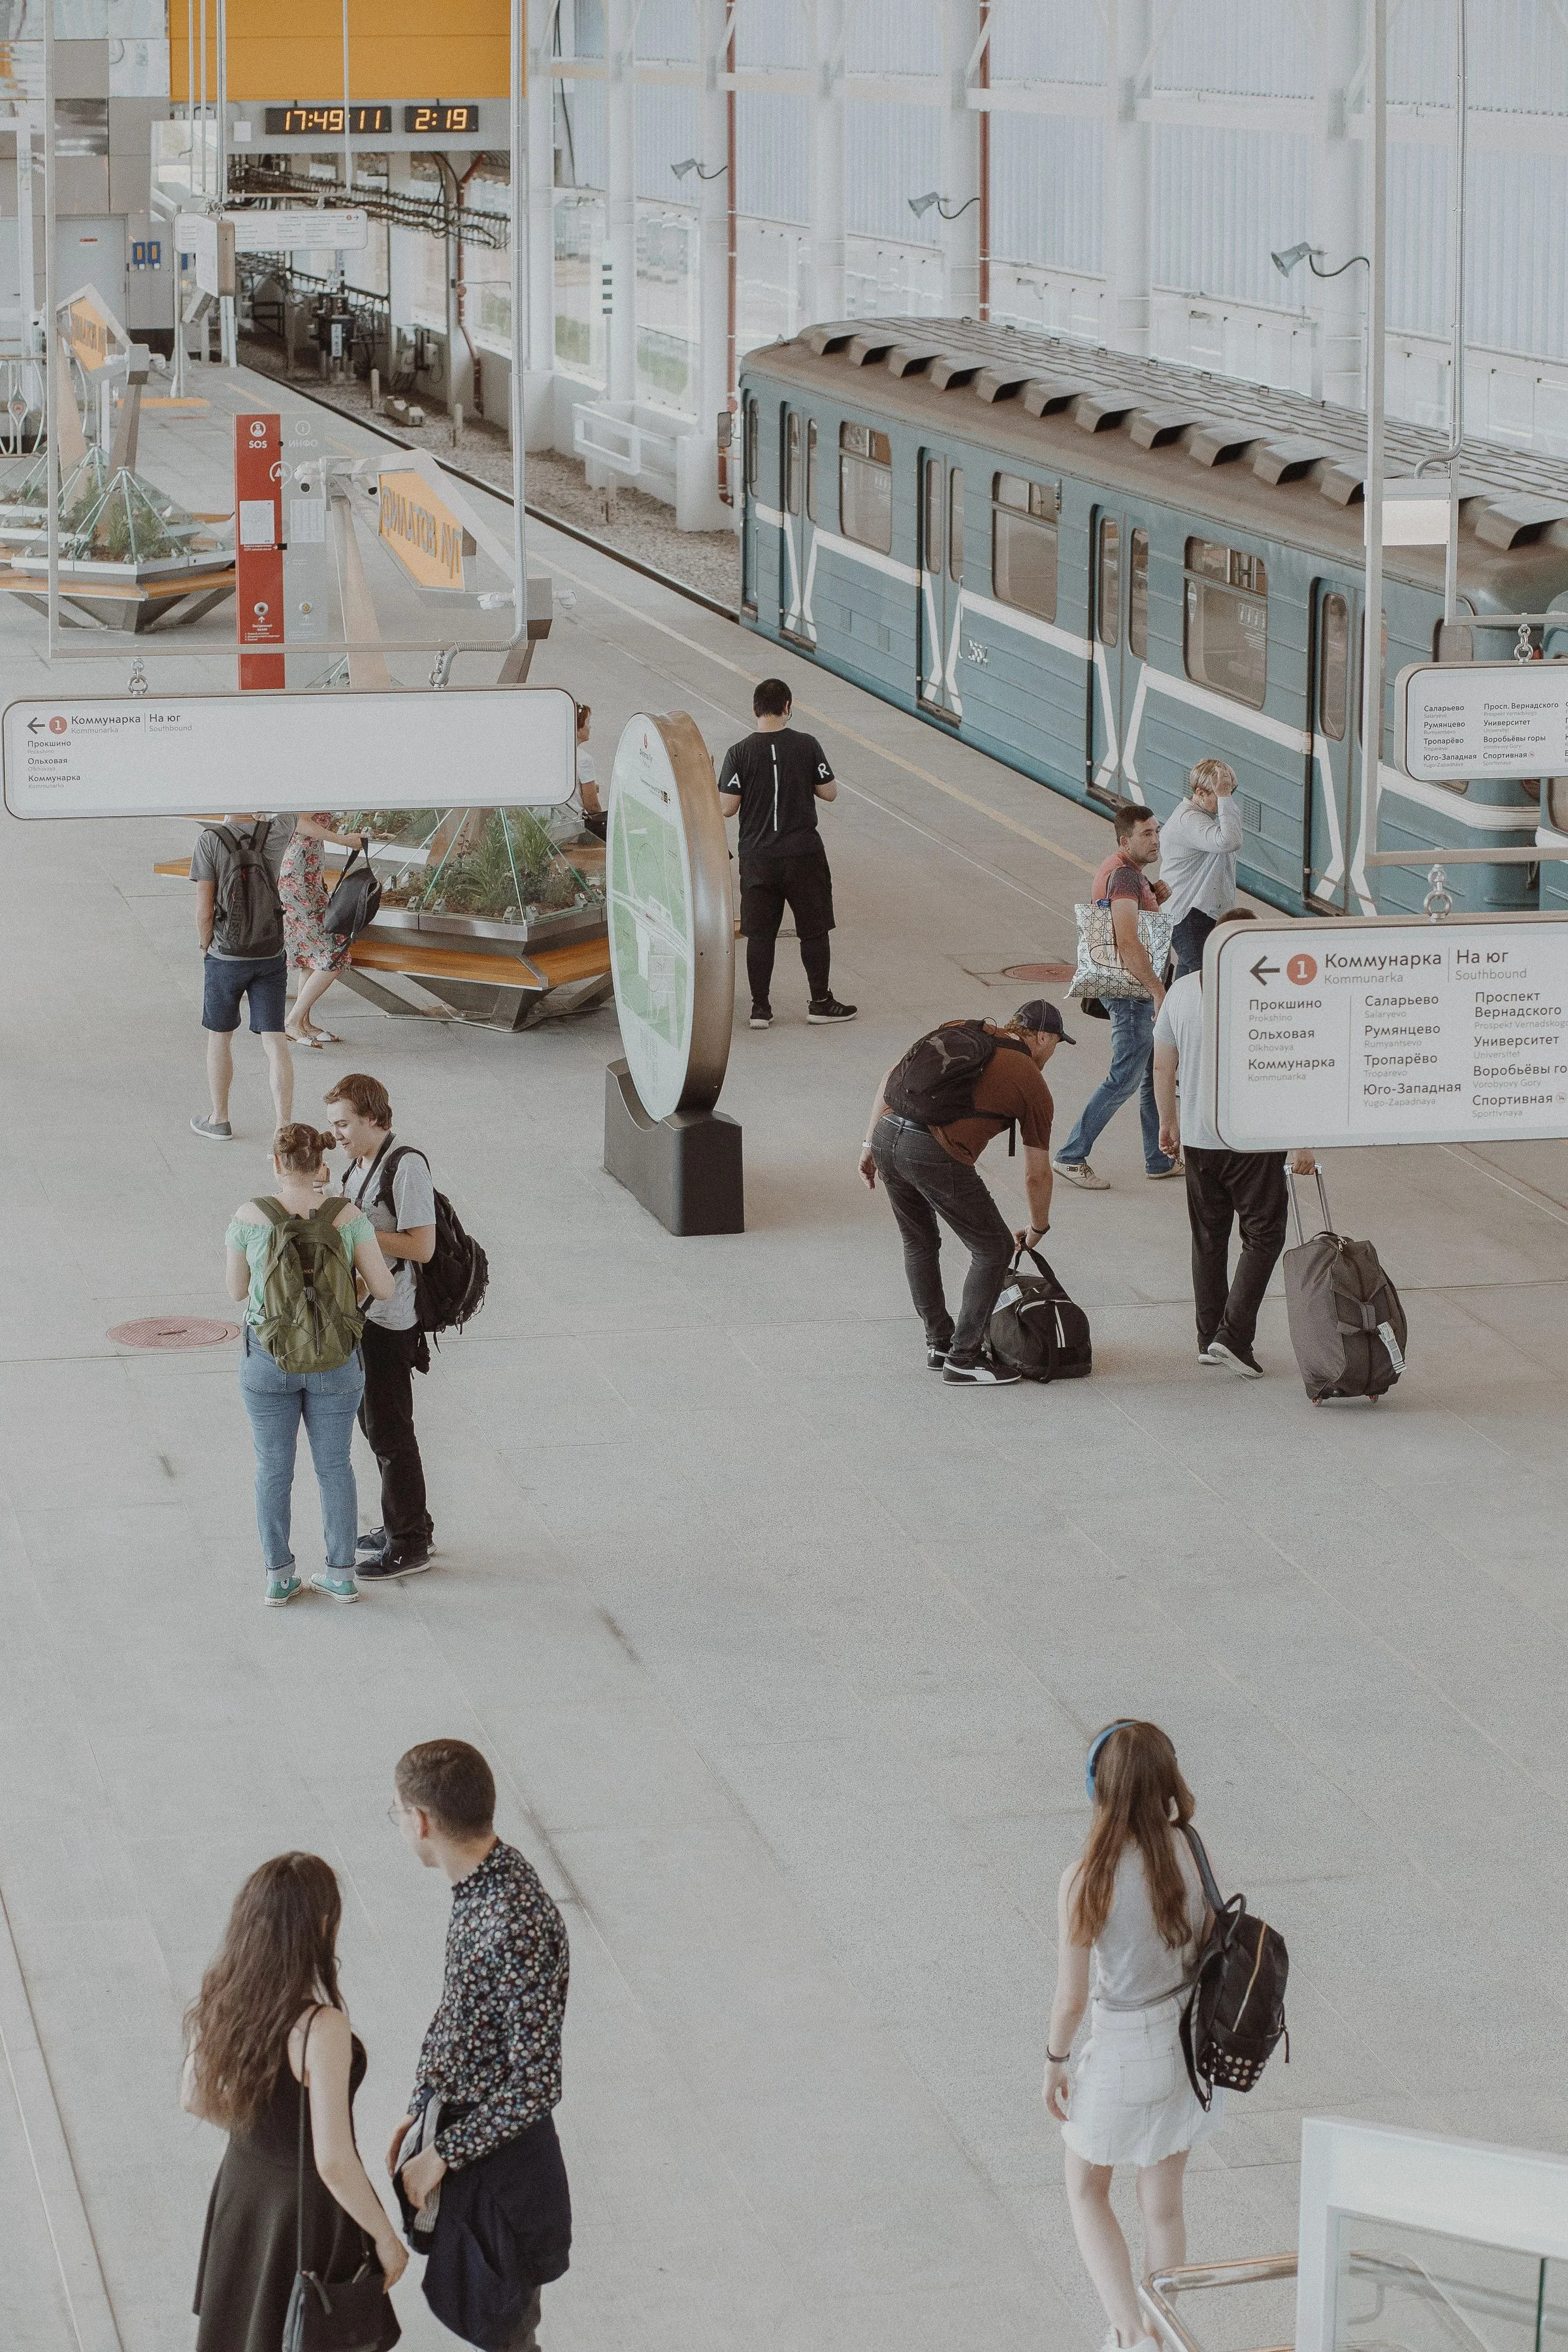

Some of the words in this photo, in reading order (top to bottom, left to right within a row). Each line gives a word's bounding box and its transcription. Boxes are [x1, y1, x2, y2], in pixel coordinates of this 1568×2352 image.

[285, 110, 381, 131] 17:4911
[415, 108, 467, 130] 2:19
[249, 440, 267, 449] SOS
[55, 720, 61, 730] 1
[71, 715, 140, 726] Коммунарка
[150, 713, 164, 723] На
[27, 740, 71, 749] Прокшино
[817, 762, 830, 778] R
[727, 773, 741, 789] A
[1457, 949, 1480, 964] На
[1486, 952, 1509, 963] юг
[1297, 960, 1307, 979] 1
[1325, 953, 1442, 970] Коммунарка
[1324, 972, 1403, 985] Kommunarka
[1456, 968, 1527, 980] Southbound
[1365, 995, 1439, 1007] Саларьево
[1475, 992, 1541, 1005] Проспект
[1250, 999, 1322, 1013] Прокшино
[1364, 1010, 1406, 1019] Salaryevo
[1475, 1007, 1561, 1019] Вернадского
[1365, 1025, 1441, 1038] Румянцево
[1475, 1021, 1512, 1030] Prospekt
[1249, 1029, 1315, 1039] Ольховая
[1474, 1036, 1559, 1048] Университет
[1249, 1058, 1335, 1071] Коммунарка
[1364, 1053, 1437, 1068] Тропарёво
[1248, 1073, 1306, 1081] Kommunarka
[1474, 1064, 1550, 1078] Воробьёвы
[1364, 1083, 1462, 1095] Юго-Западная
[1473, 1095, 1552, 1107] Спортивная
